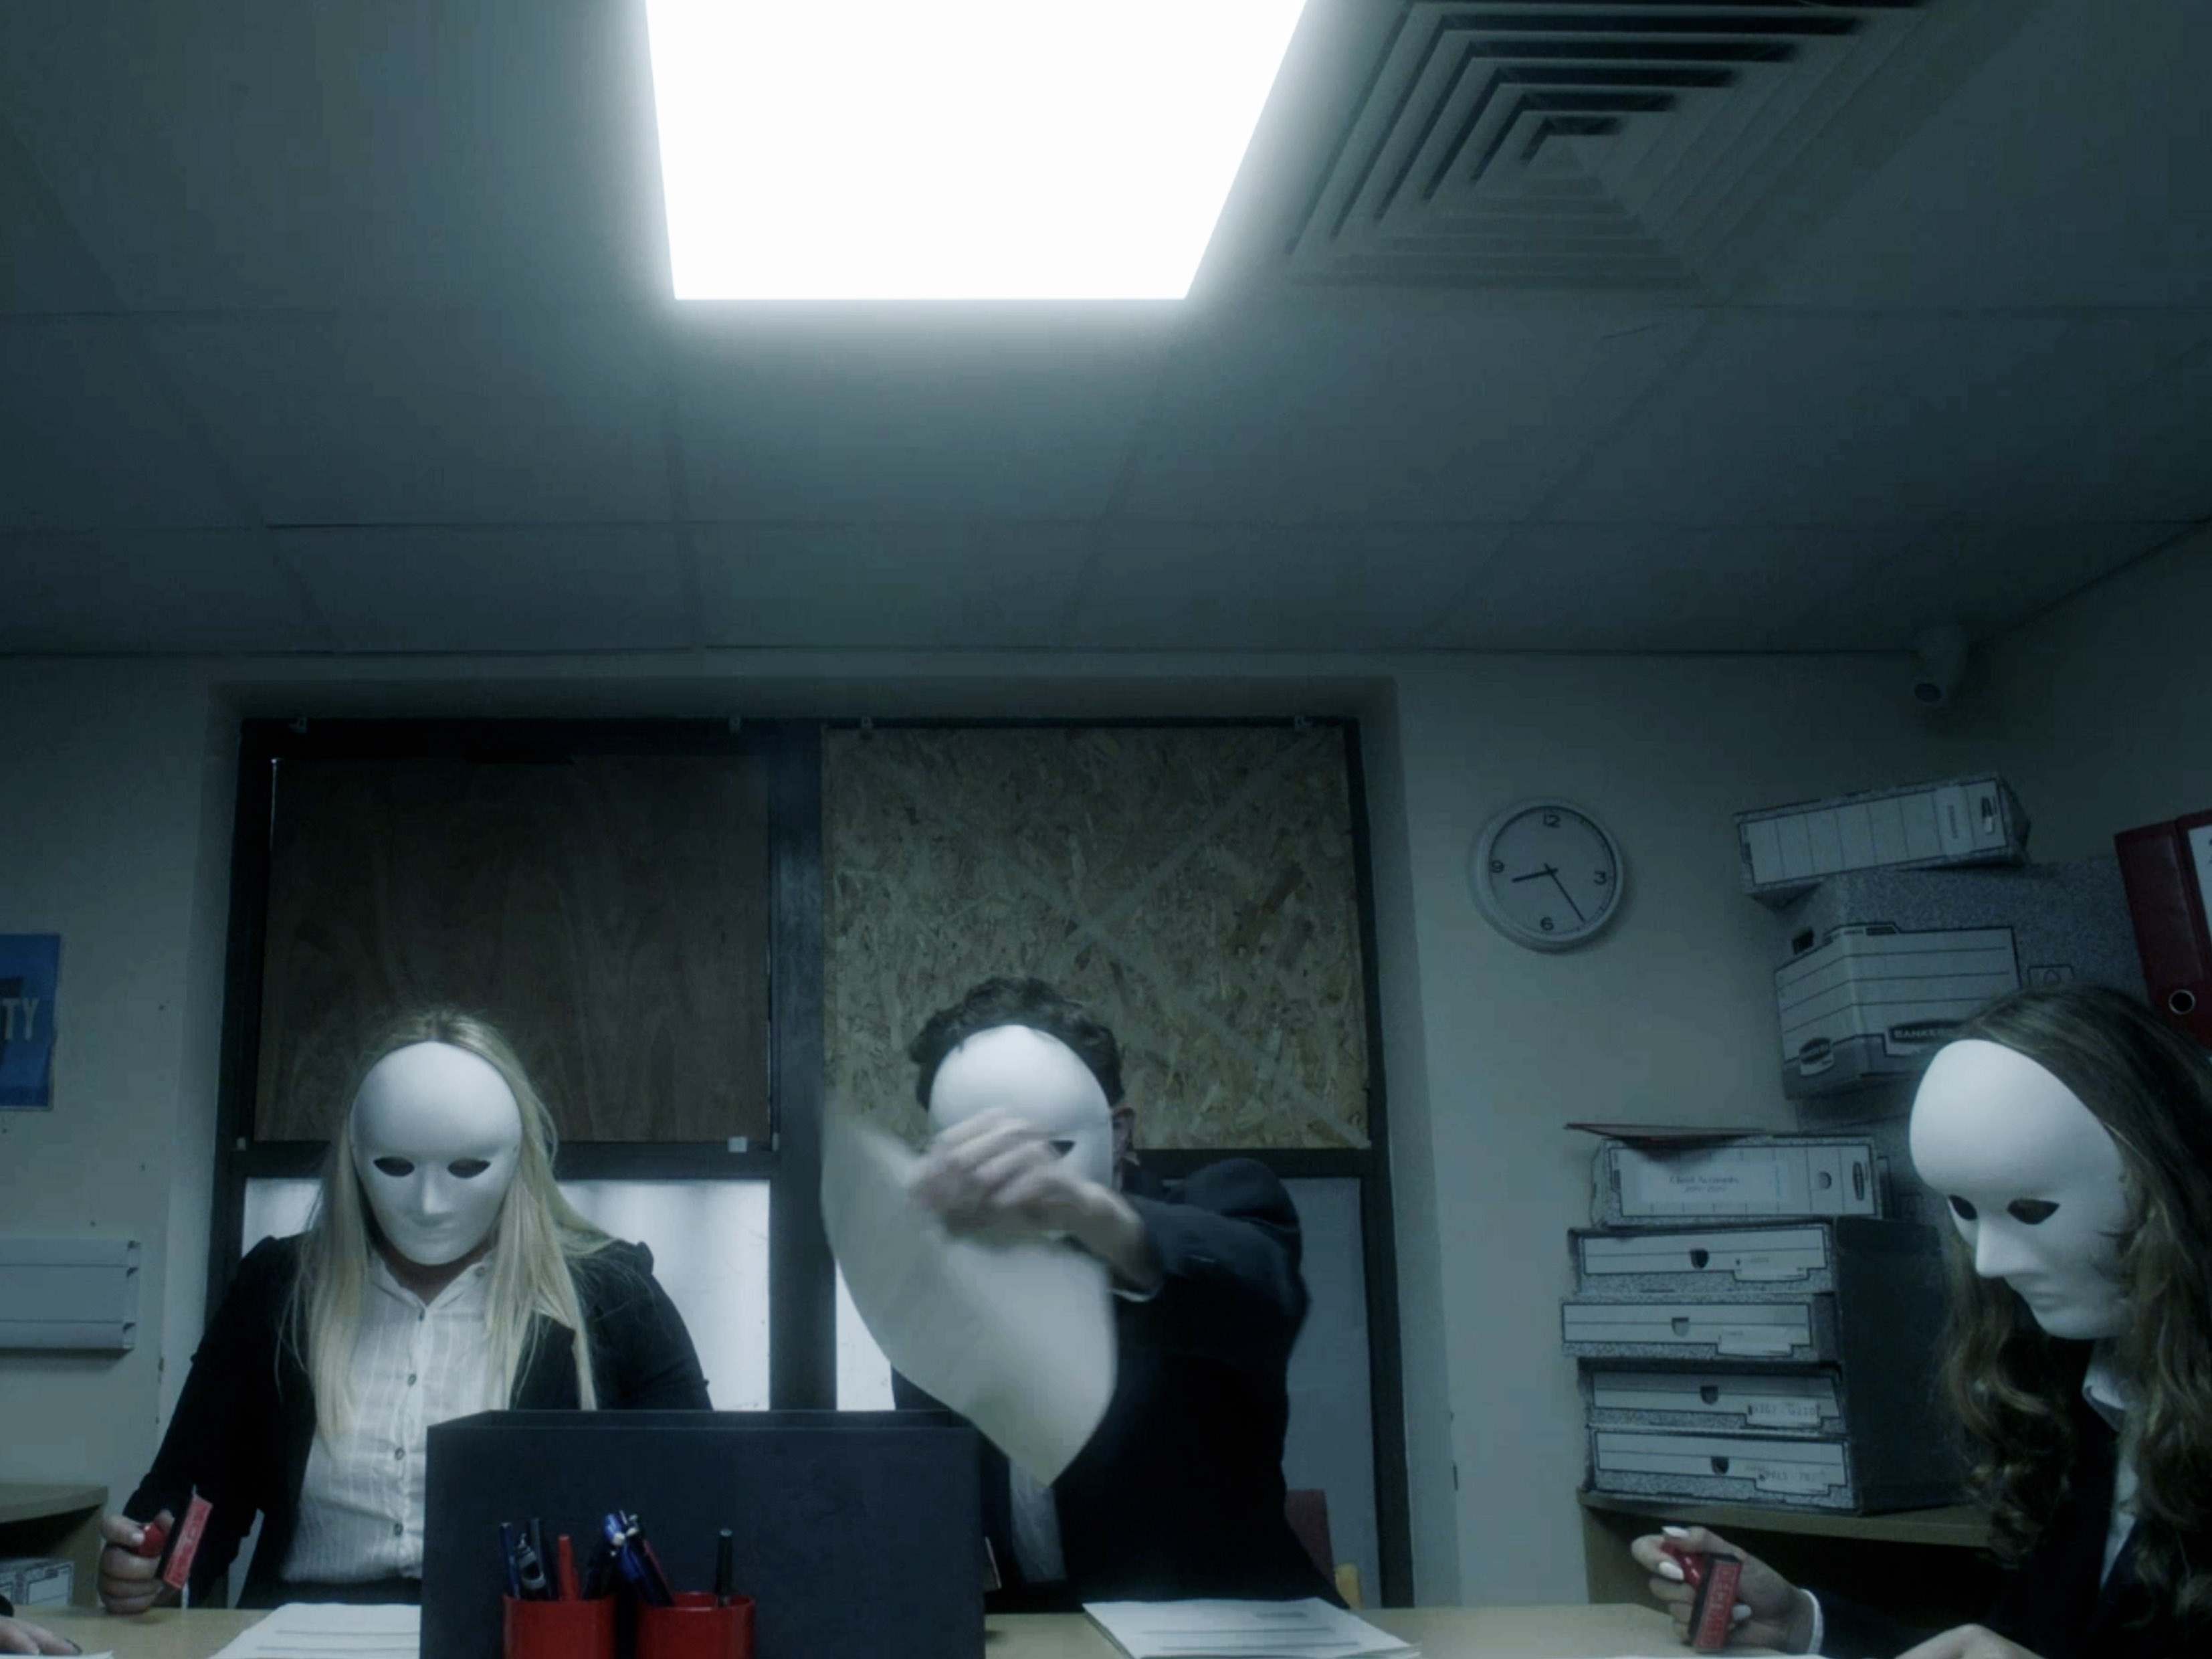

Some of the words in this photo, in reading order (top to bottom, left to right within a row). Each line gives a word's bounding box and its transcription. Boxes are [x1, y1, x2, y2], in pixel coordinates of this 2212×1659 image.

[1543, 814, 1561, 828] 12
[1492, 860, 1505, 873] 9
[1593, 870, 1607, 885] 3
[1540, 917, 1554, 931] 6
